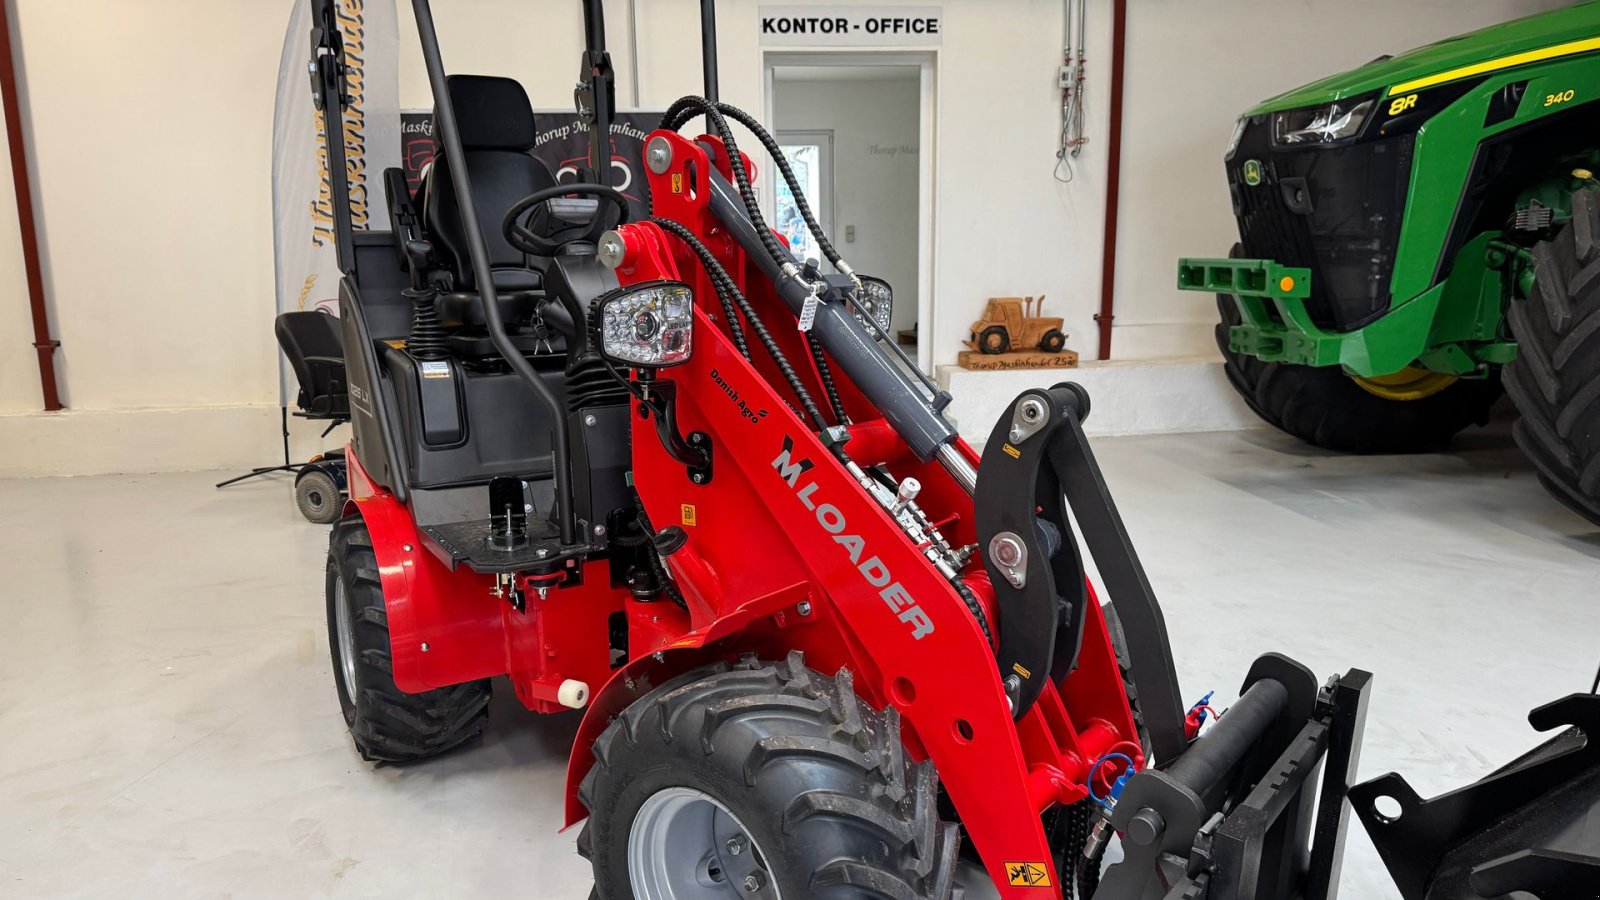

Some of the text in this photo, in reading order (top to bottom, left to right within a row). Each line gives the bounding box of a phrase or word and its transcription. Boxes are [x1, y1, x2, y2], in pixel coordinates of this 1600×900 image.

[762, 18, 848, 34] KONTOR
[865, 18, 938, 34] OFFICE
[1388, 94, 1418, 116] 8R
[1544, 89, 1575, 107] 340
[534, 125, 570, 149] horup
[710, 367, 759, 424] Danish Agro
